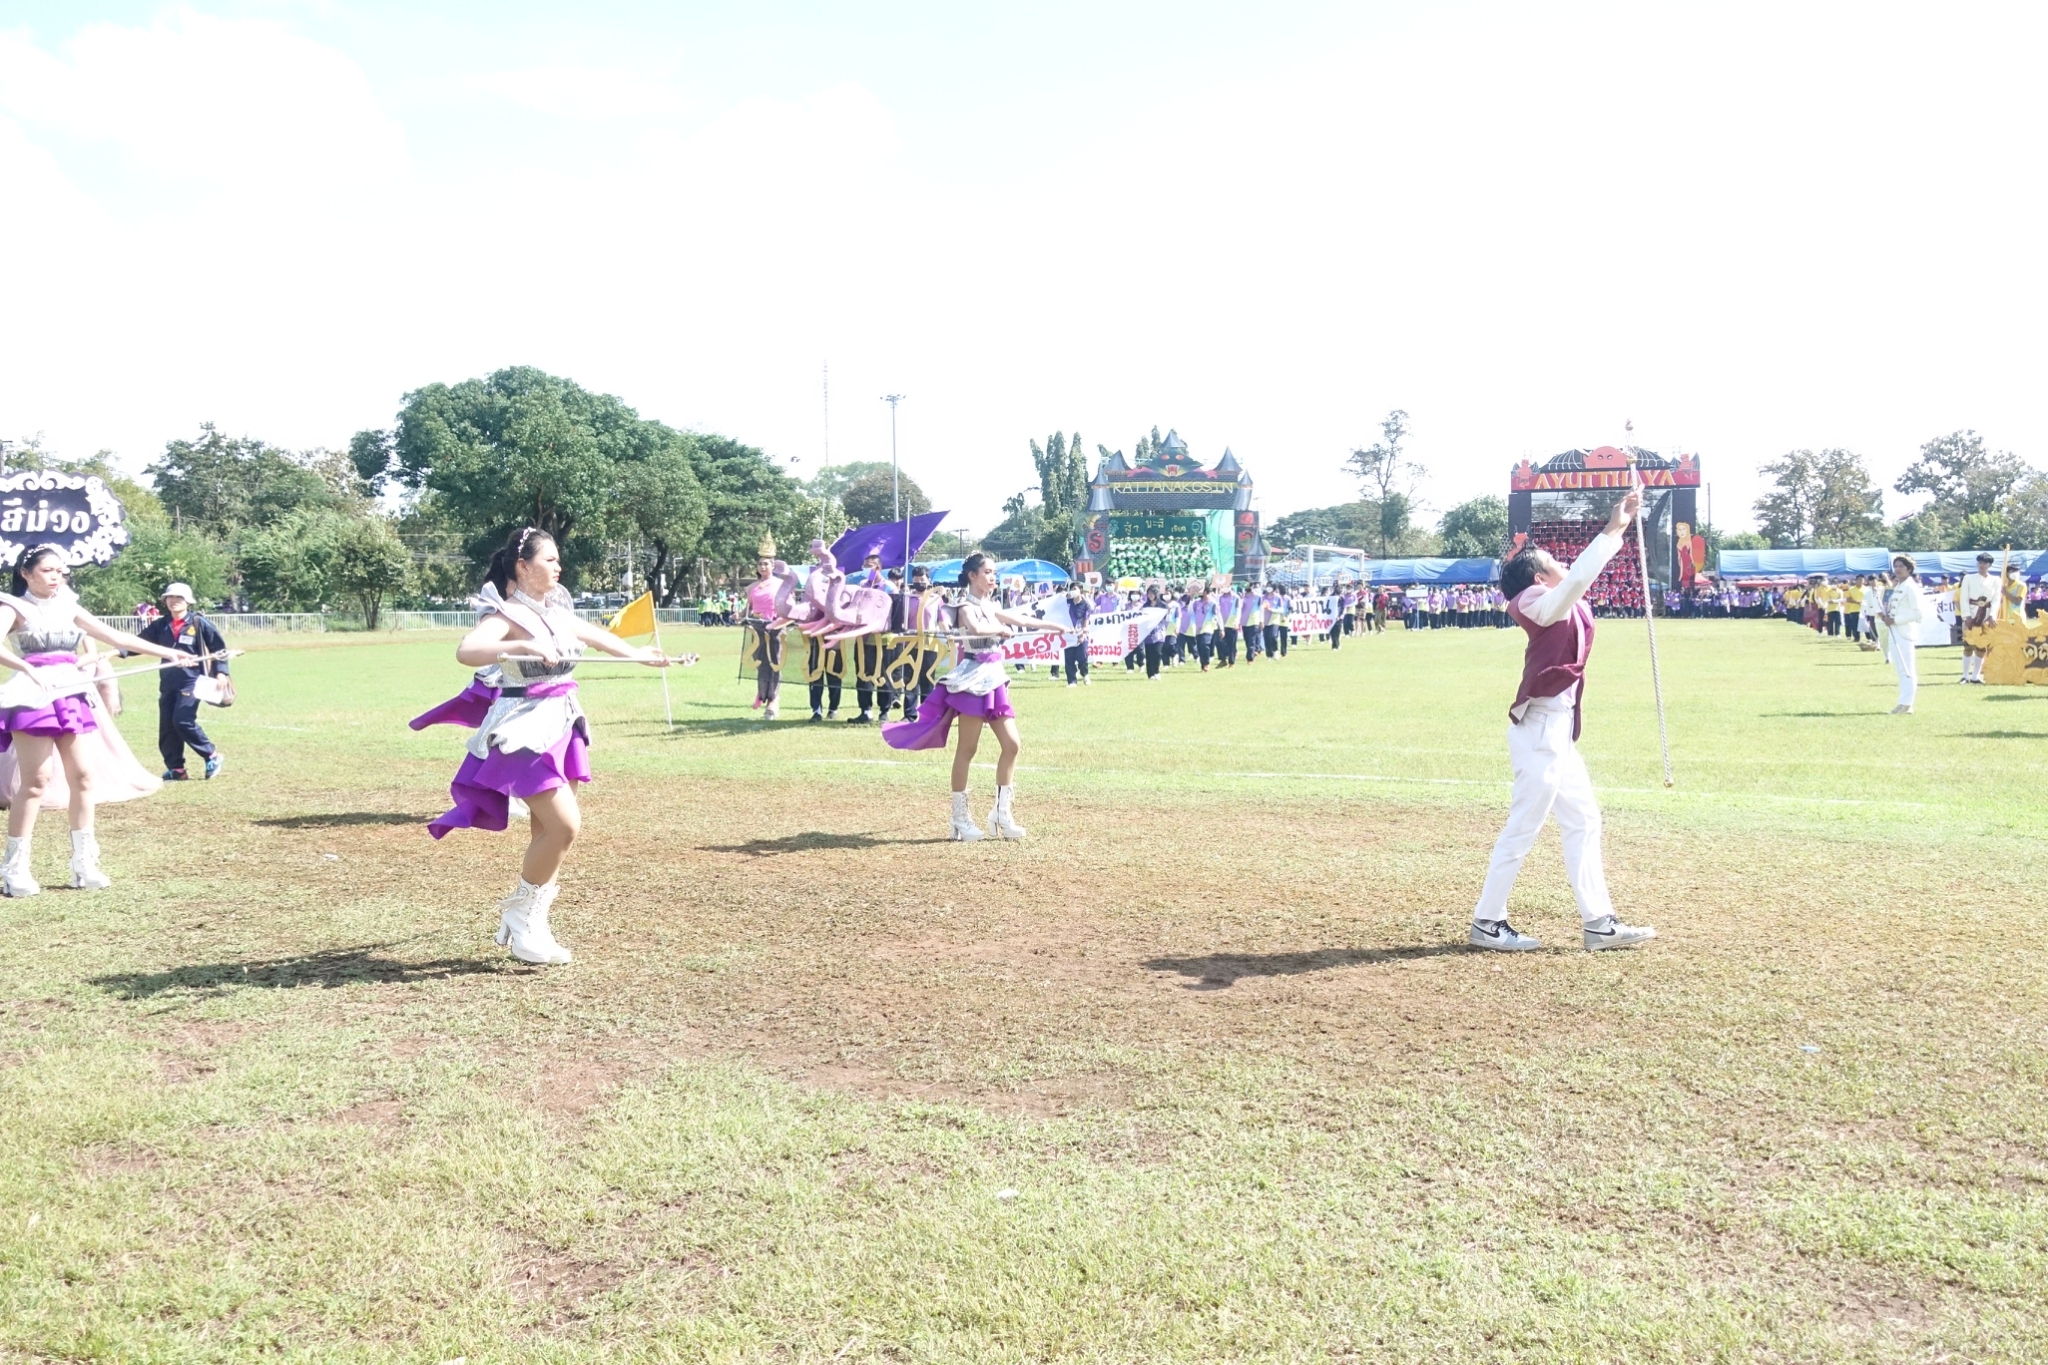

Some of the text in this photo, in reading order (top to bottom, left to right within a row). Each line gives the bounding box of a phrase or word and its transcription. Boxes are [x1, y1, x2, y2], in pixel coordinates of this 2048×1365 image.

[1113, 481, 1233, 494] RATTANAKOSIN
[1, 497, 91, 534] สีม่วง
